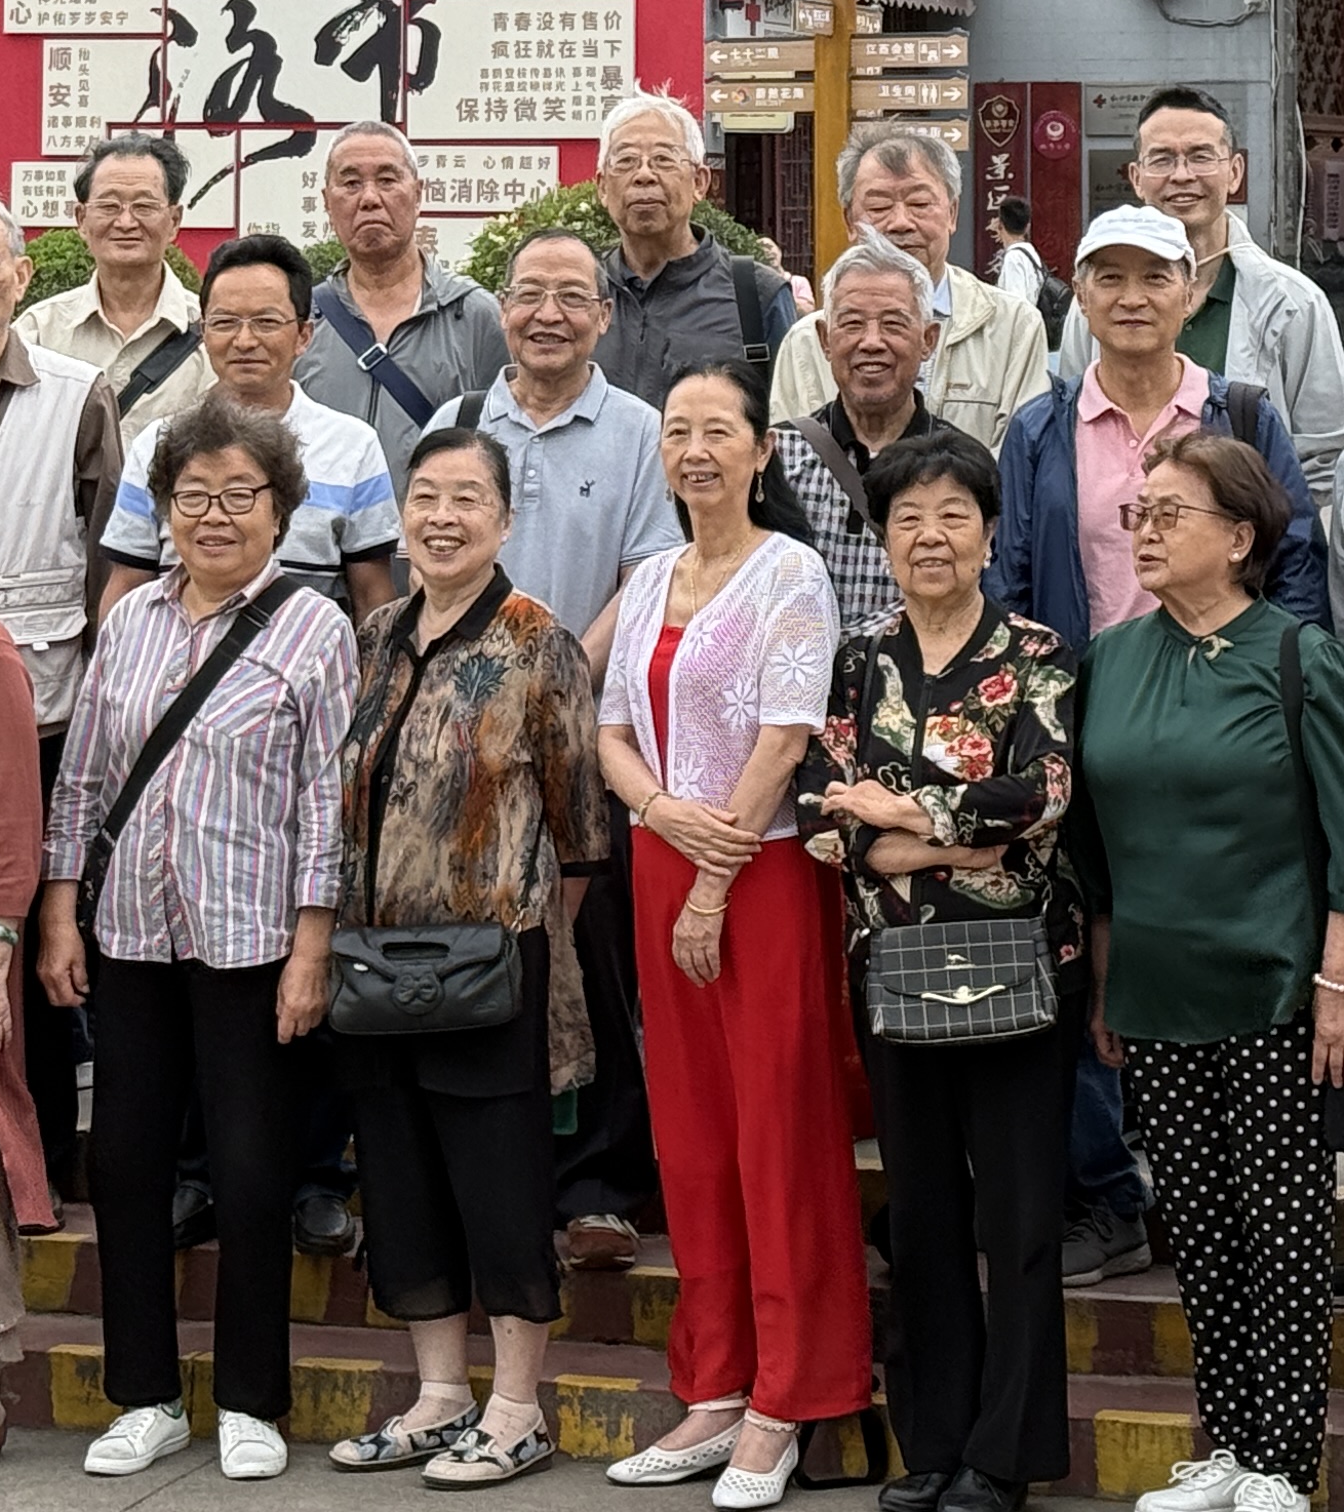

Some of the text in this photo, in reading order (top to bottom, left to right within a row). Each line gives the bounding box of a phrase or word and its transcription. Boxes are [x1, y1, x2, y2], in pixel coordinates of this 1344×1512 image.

[37, 10, 129, 26] 护佑岁岁安宁
[492, 10, 623, 33] 青春没有售价
[491, 38, 623, 59] 疯狂就在当下
[78, 47, 90, 108] 抬头见喜
[455, 96, 567, 123] 保持微笑
[47, 115, 102, 129] 诸事顺利
[417, 154, 467, 169] 步青云
[483, 155, 552, 170] 心情超好
[22, 170, 67, 182] 万事如意
[423, 177, 557, 204] 恼消除中心
[21, 200, 76, 219] 心想事
[301, 171, 318, 238] 好事发
